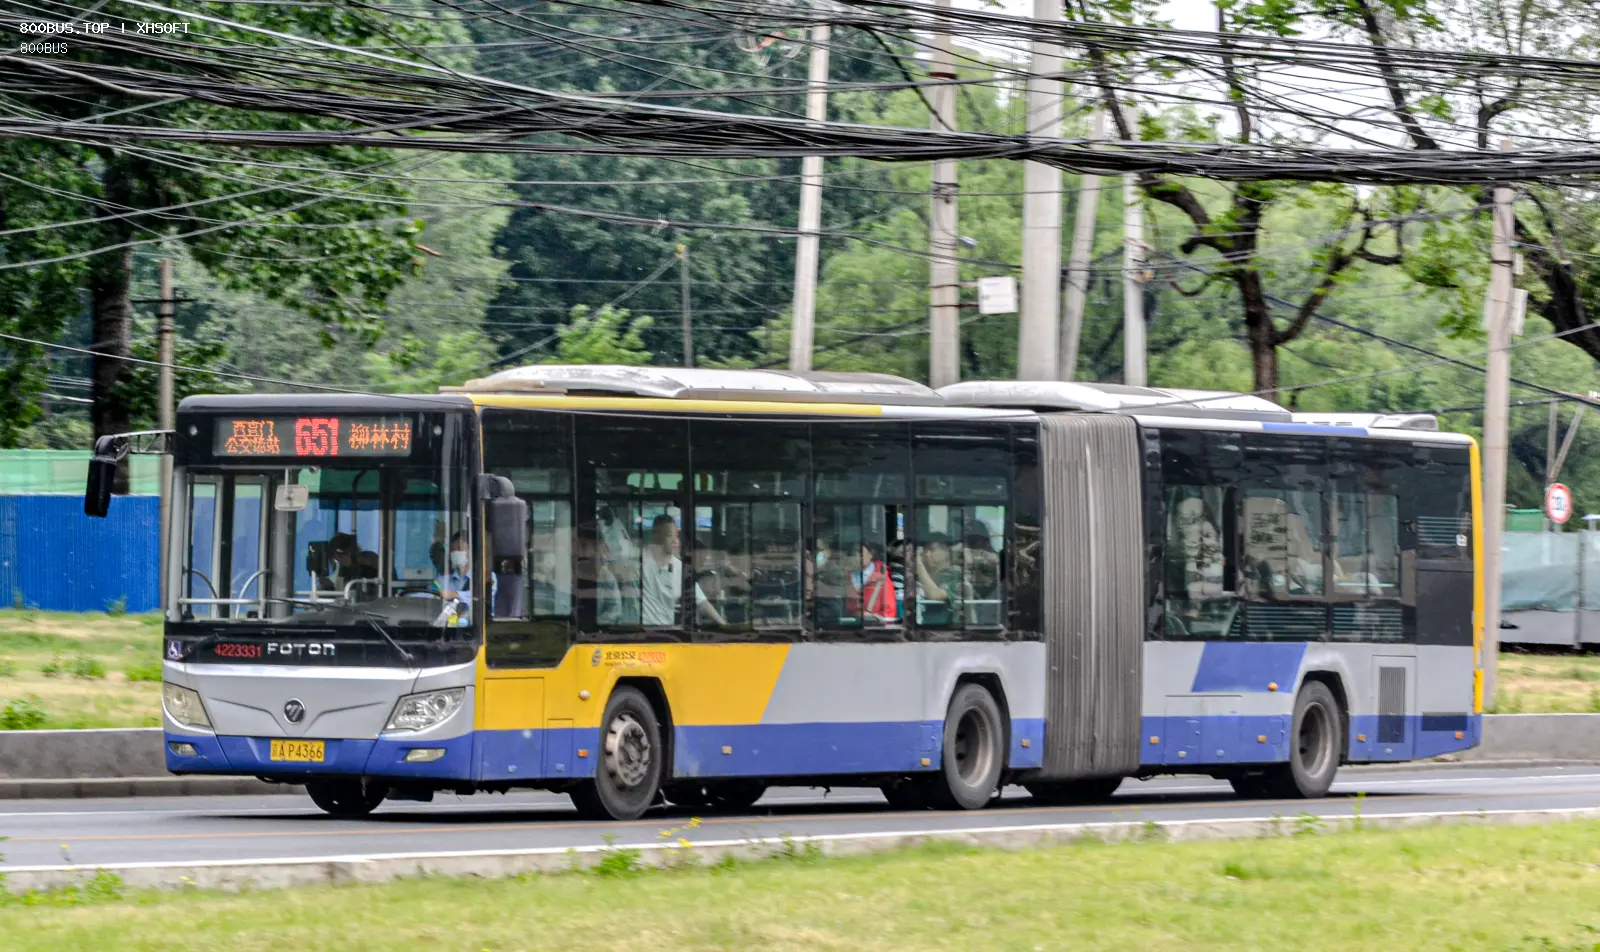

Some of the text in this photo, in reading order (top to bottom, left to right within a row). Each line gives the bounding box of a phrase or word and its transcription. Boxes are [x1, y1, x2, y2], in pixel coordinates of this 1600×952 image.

[295, 416, 340, 456] 651
[349, 422, 411, 450] 柳林村
[213, 643, 262, 658] 4223331
